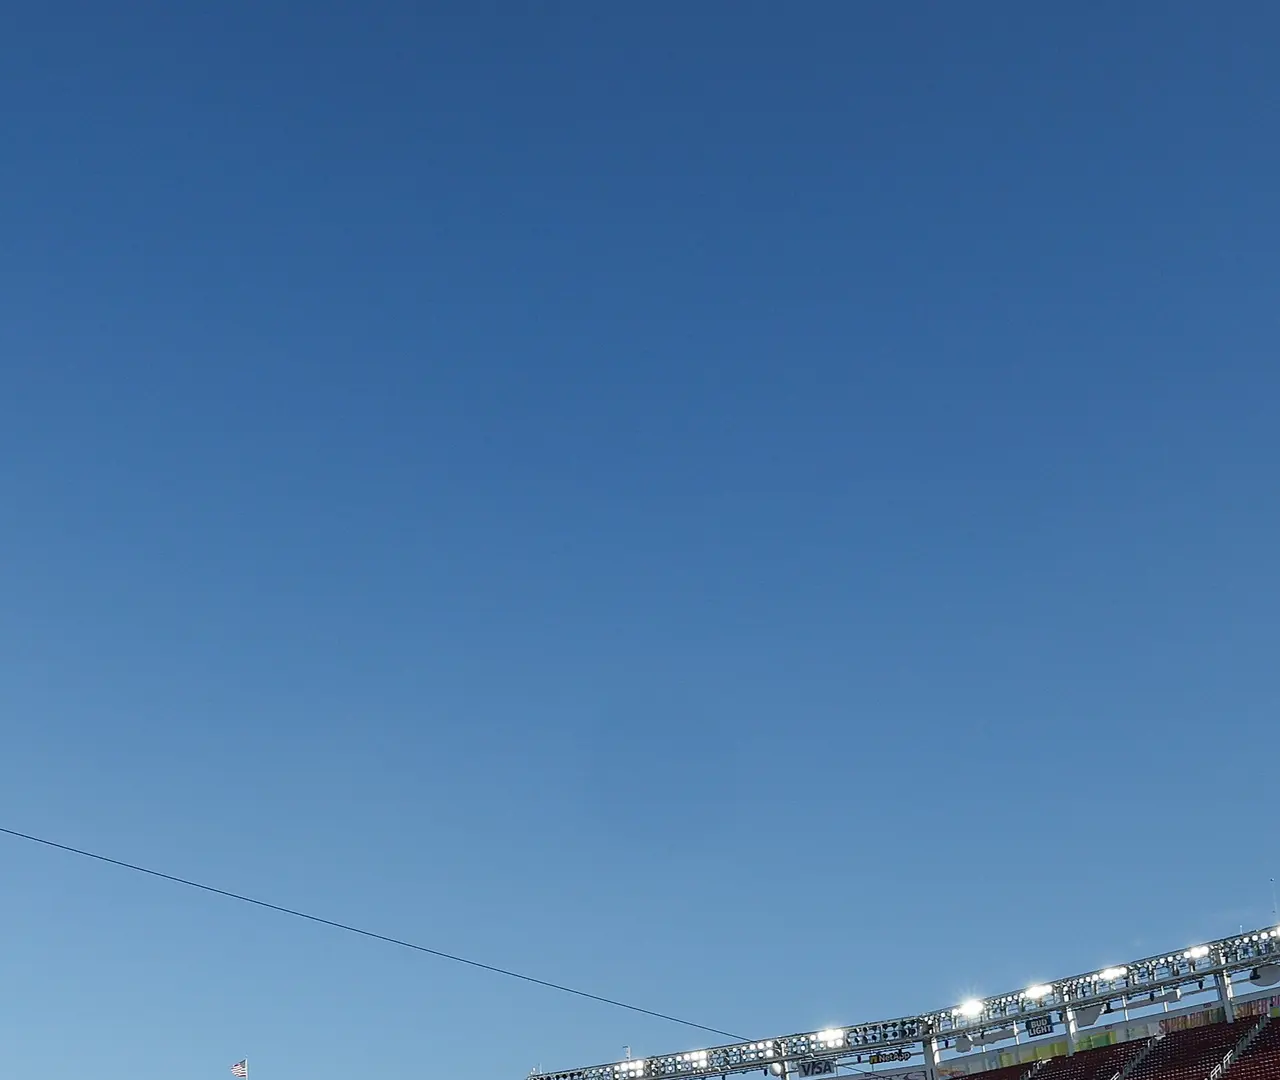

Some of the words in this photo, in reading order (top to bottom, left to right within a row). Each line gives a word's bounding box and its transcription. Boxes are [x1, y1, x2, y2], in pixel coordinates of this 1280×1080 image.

[1031, 1019, 1048, 1029] BUD
[1029, 1025, 1052, 1036] LIGHT
[879, 1051, 911, 1063] NetApp
[800, 1060, 831, 1077] VISA
